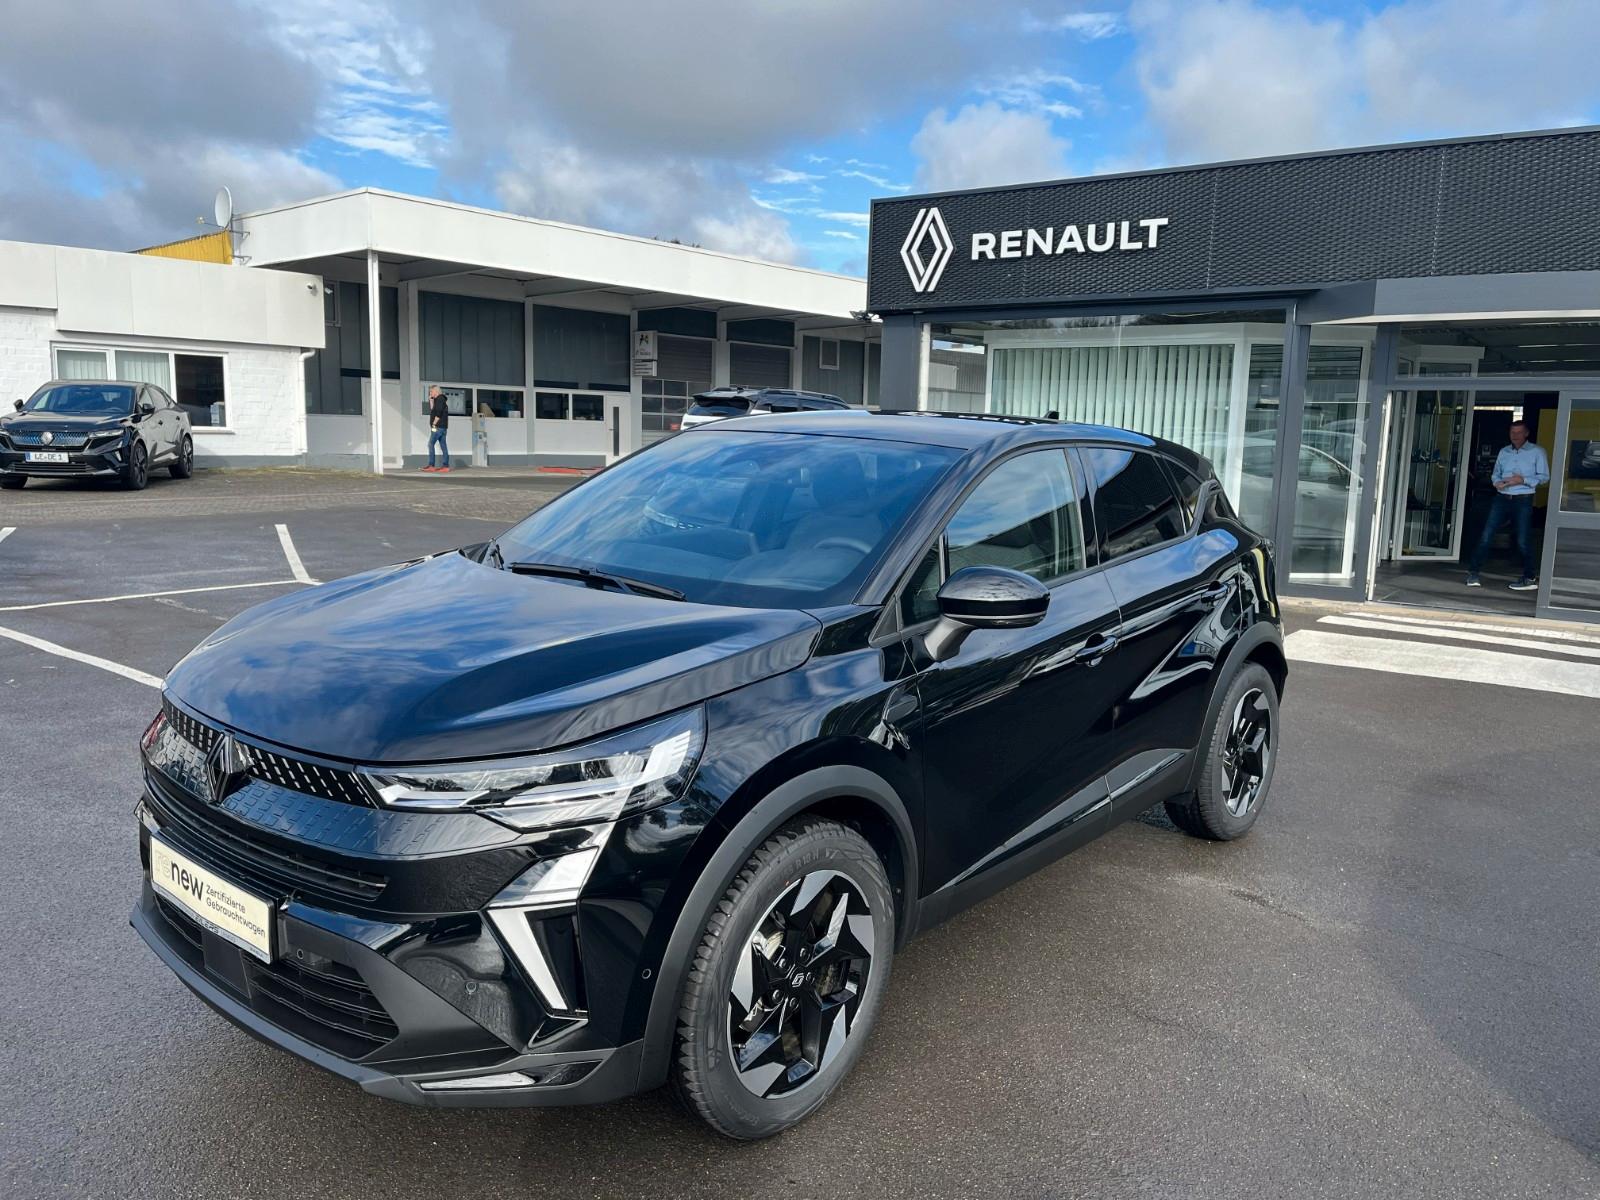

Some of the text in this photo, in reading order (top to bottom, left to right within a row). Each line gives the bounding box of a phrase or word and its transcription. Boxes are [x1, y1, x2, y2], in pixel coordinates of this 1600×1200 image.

[971, 217, 1169, 260] RENAULT
[206, 884, 246, 914] Zertifizierte
[206, 897, 266, 939] Gebrauchtwagen
